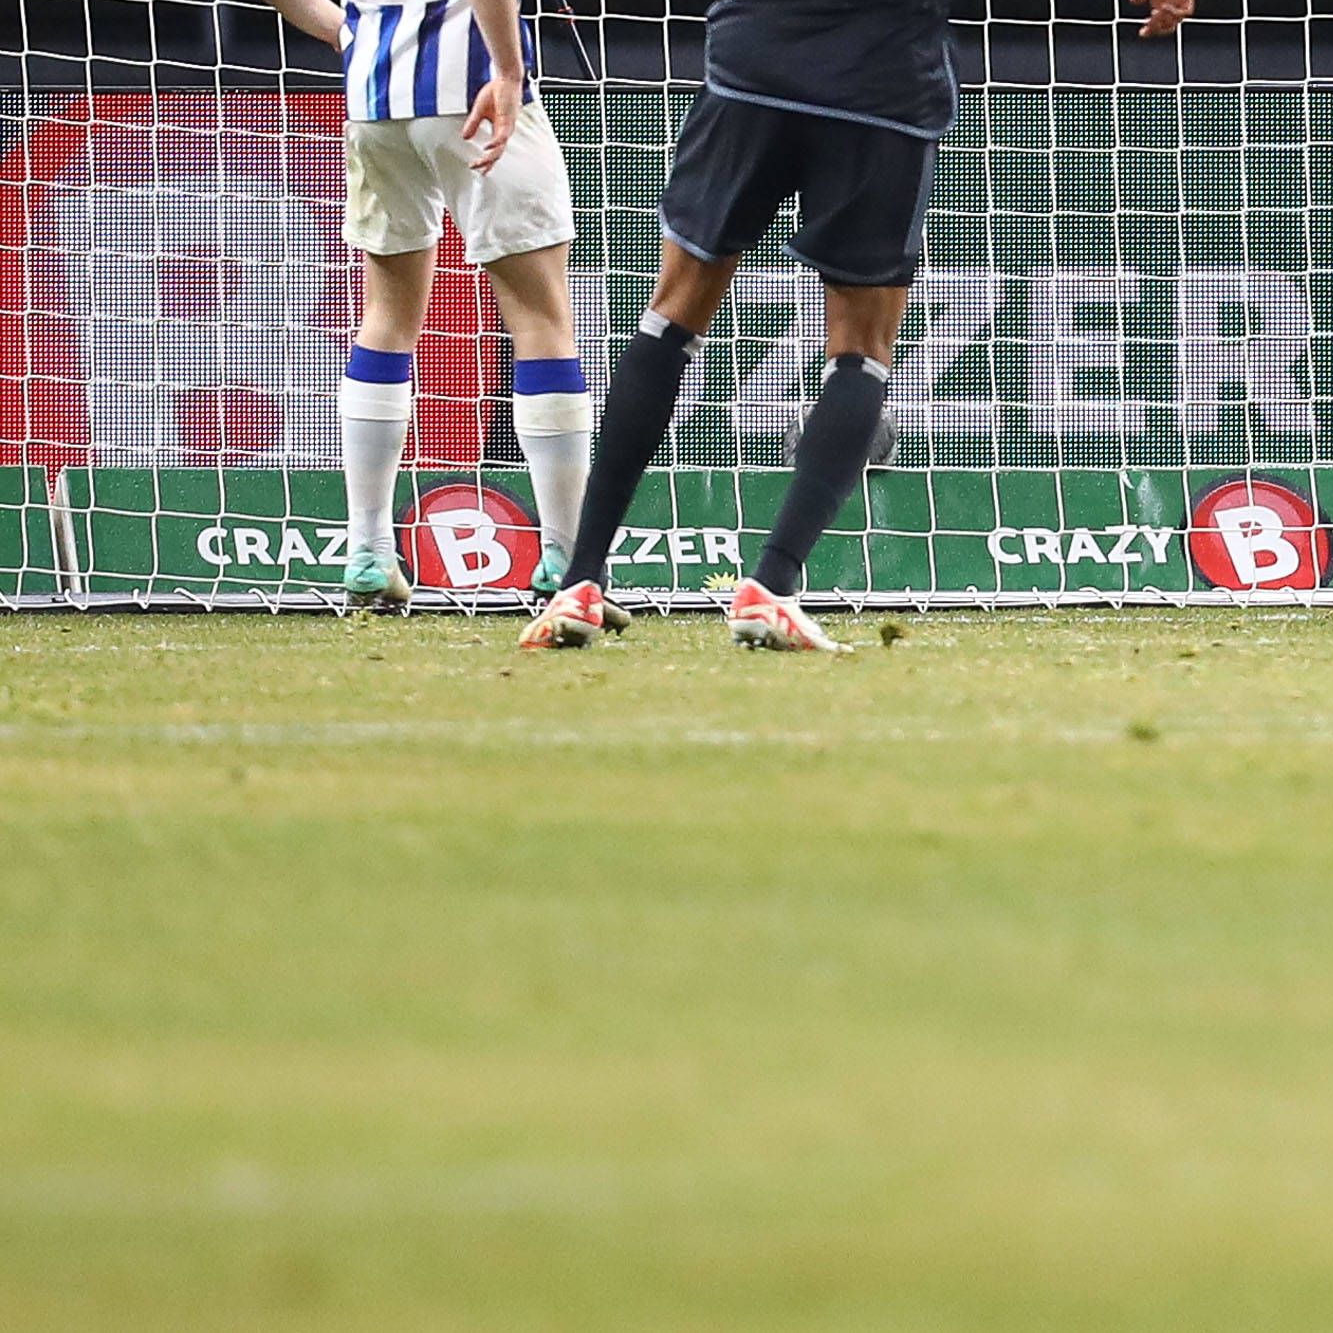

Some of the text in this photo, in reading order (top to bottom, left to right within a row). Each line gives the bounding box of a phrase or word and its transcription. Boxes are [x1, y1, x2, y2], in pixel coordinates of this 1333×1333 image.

[197, 509, 744, 588] CRAZ B ZZER
[987, 526, 1173, 565] CRAZY
[1215, 506, 1300, 584] B
